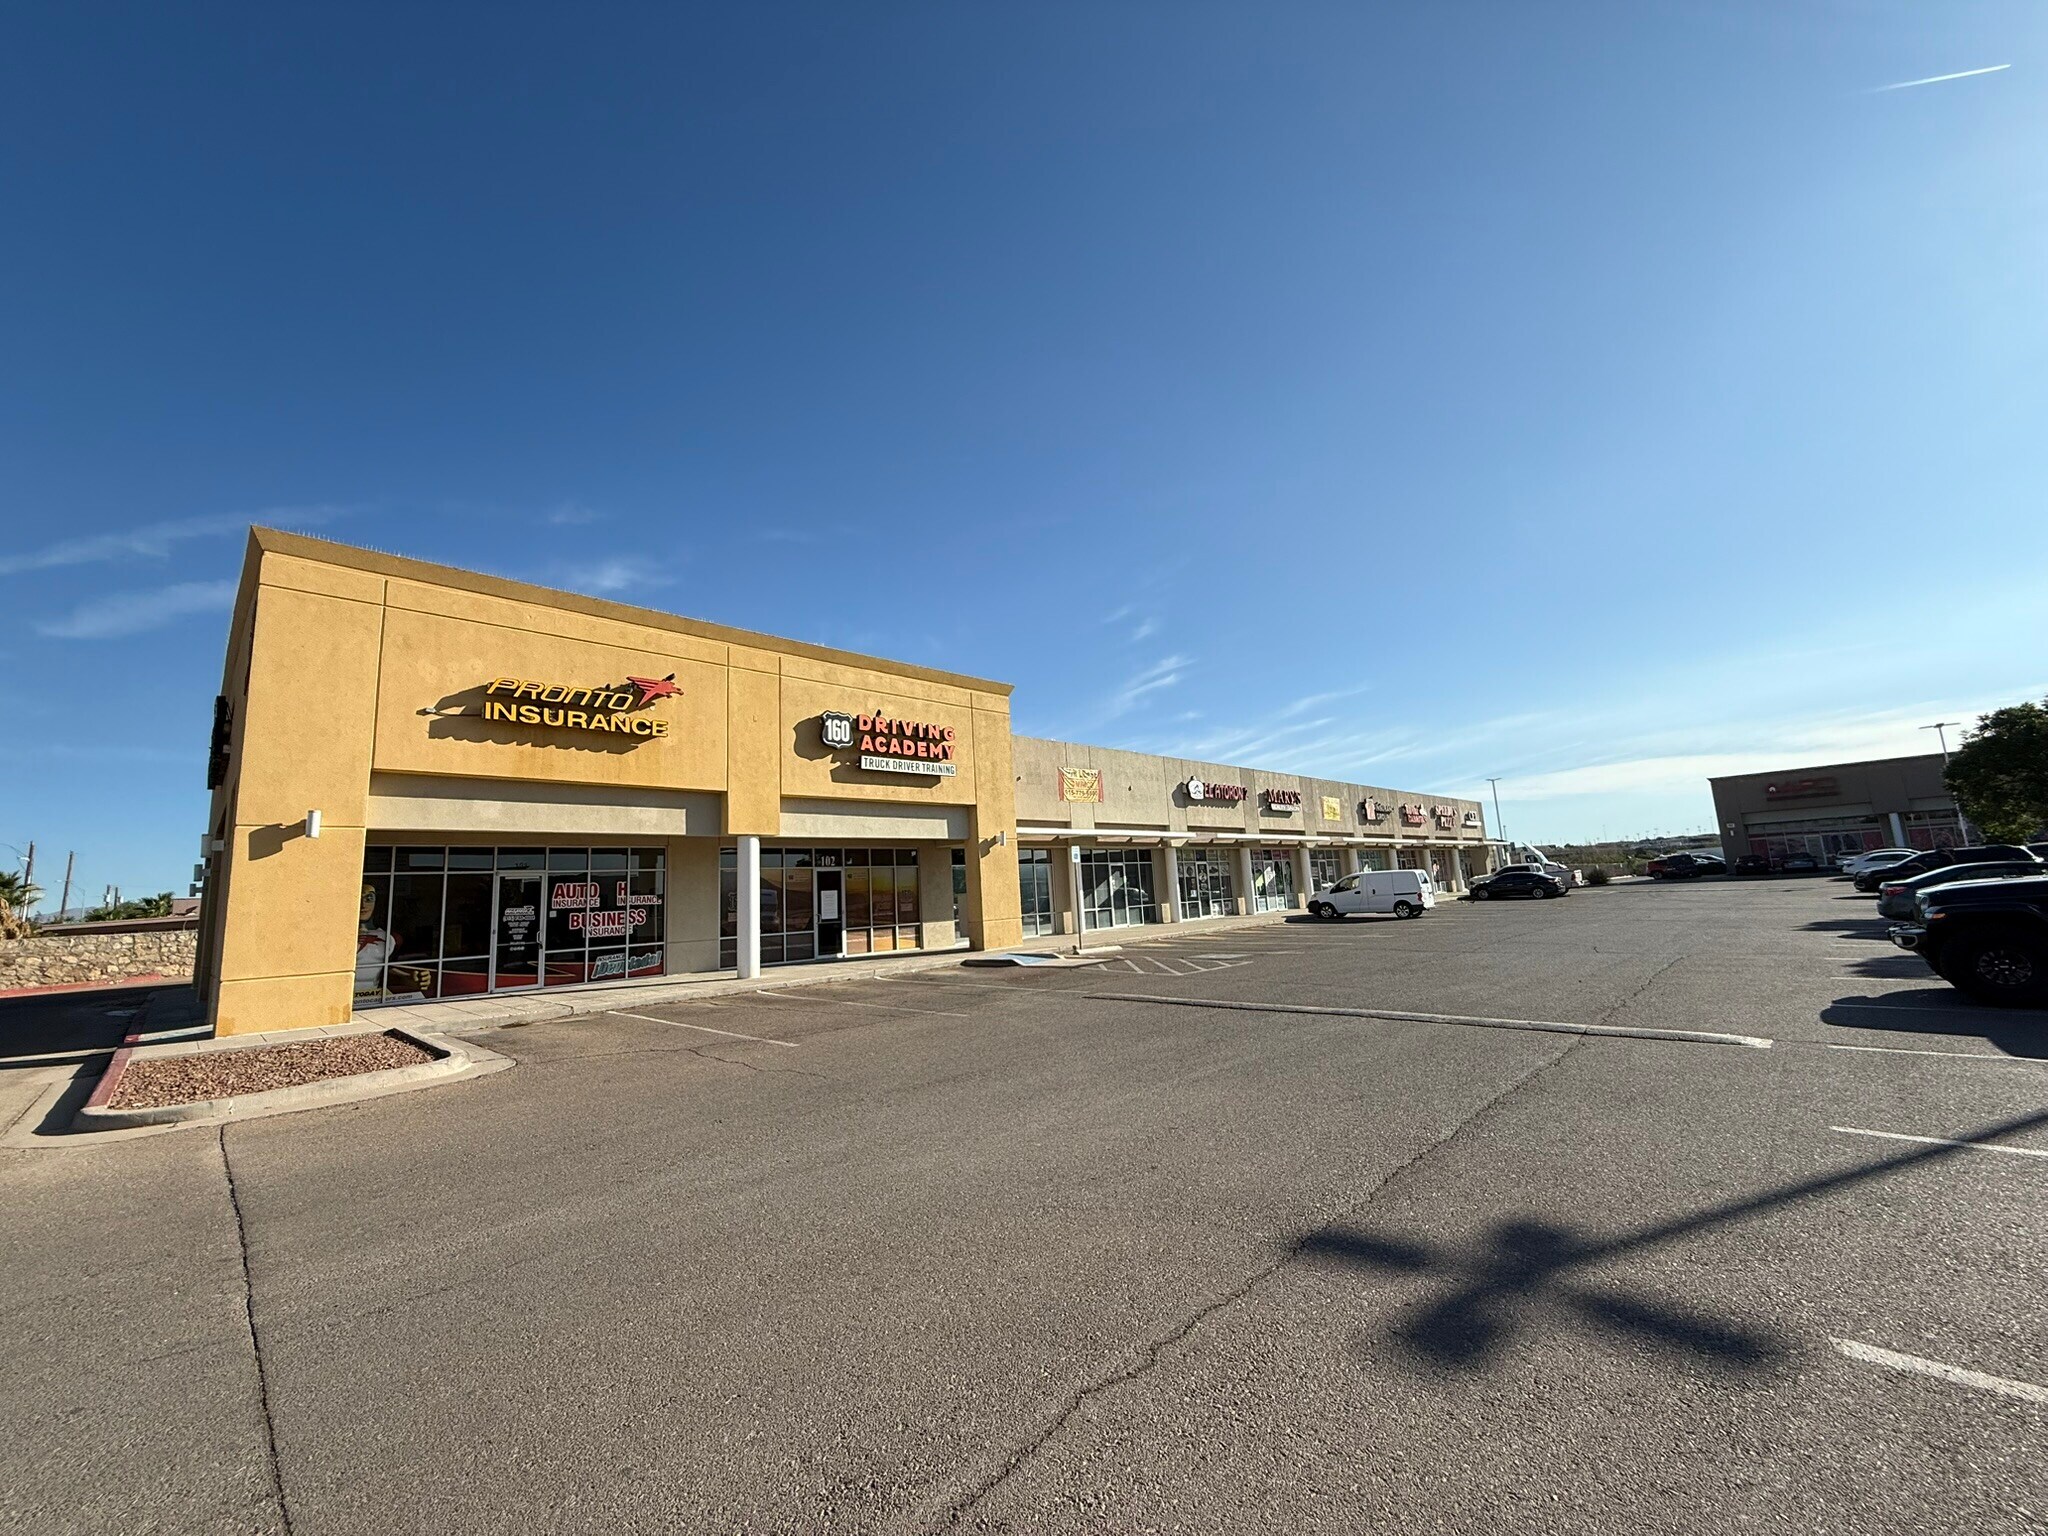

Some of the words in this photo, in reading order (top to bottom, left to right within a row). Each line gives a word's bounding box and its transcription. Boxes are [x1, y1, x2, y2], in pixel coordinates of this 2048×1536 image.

[486, 677, 634, 711] PRONTO
[484, 701, 669, 737] INSURANCE
[858, 714, 956, 741] DRIVING
[825, 718, 850, 742] 160
[860, 735, 956, 760] ACADEMY
[863, 757, 891, 770] TRUCK
[893, 760, 920, 772] DRIVER
[921, 763, 955, 775] TRAINING
[1266, 788, 1302, 805] MARY'S
[821, 855, 836, 867] 102
[552, 882, 600, 899] AUTO
[552, 897, 600, 909] INSURANCE
[569, 909, 647, 930] BUSINESS
[597, 953, 626, 962] INSURANC
